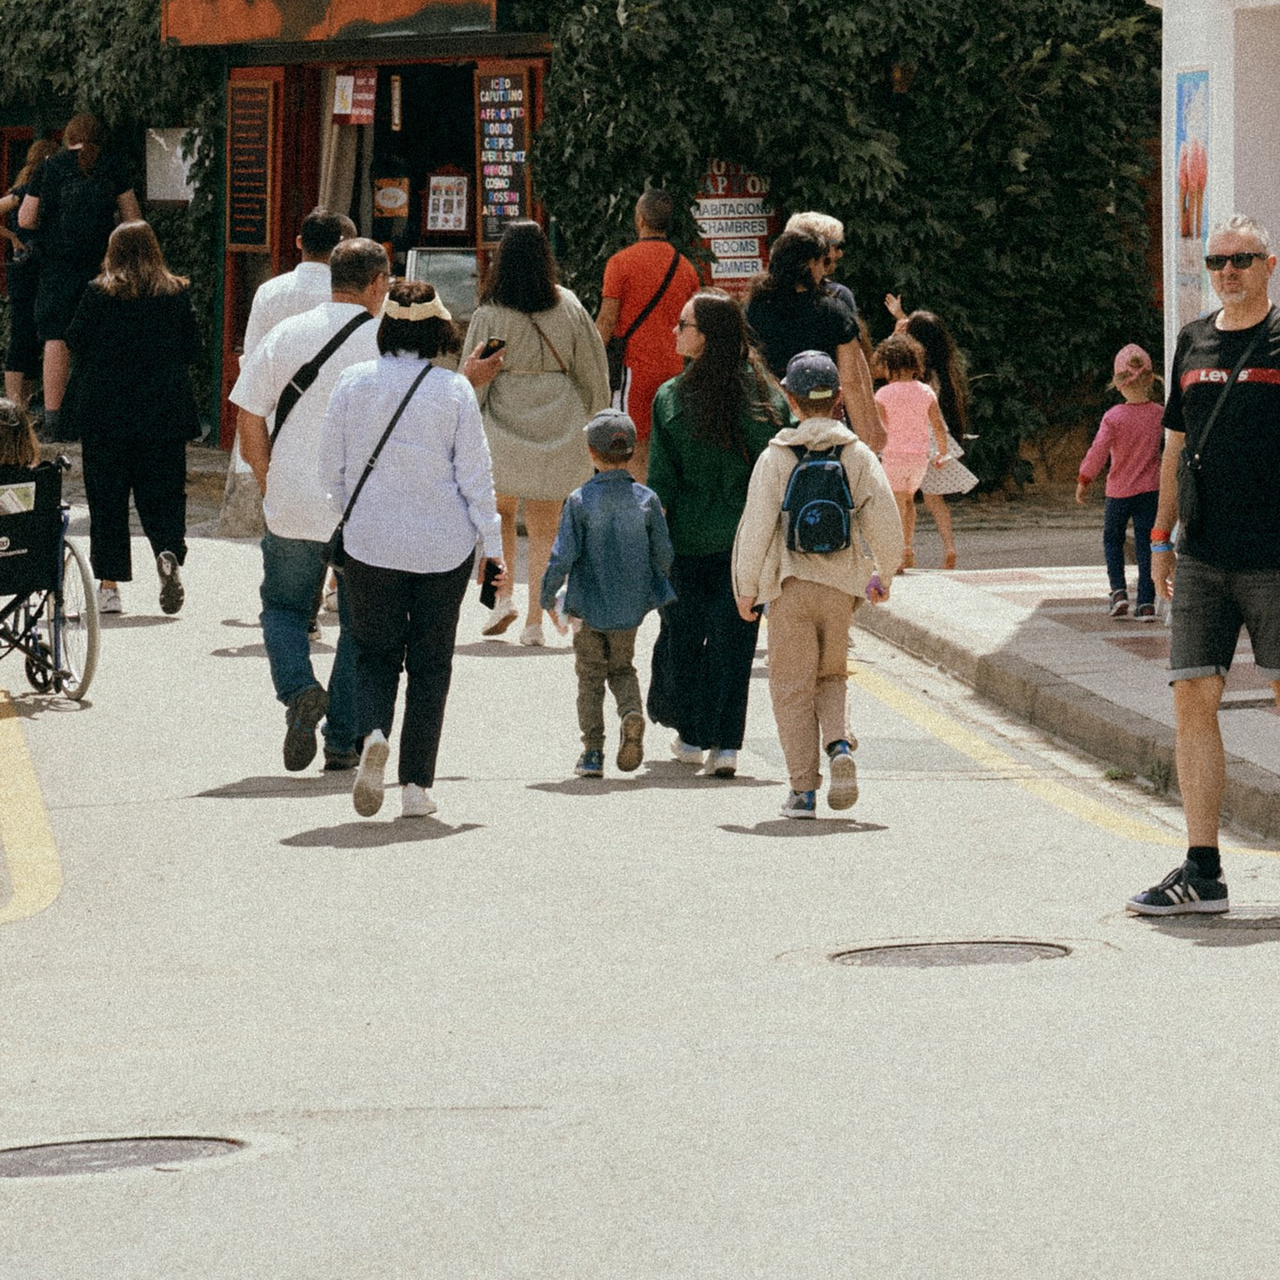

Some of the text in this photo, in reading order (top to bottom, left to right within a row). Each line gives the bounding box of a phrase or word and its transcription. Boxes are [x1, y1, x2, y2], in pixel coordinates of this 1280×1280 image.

[700, 221, 766, 233] CHAMBRES
[713, 241, 757, 253] ROOMS
[715, 261, 759, 273] ZIMMER
[1200, 369, 1249, 382] Levs
